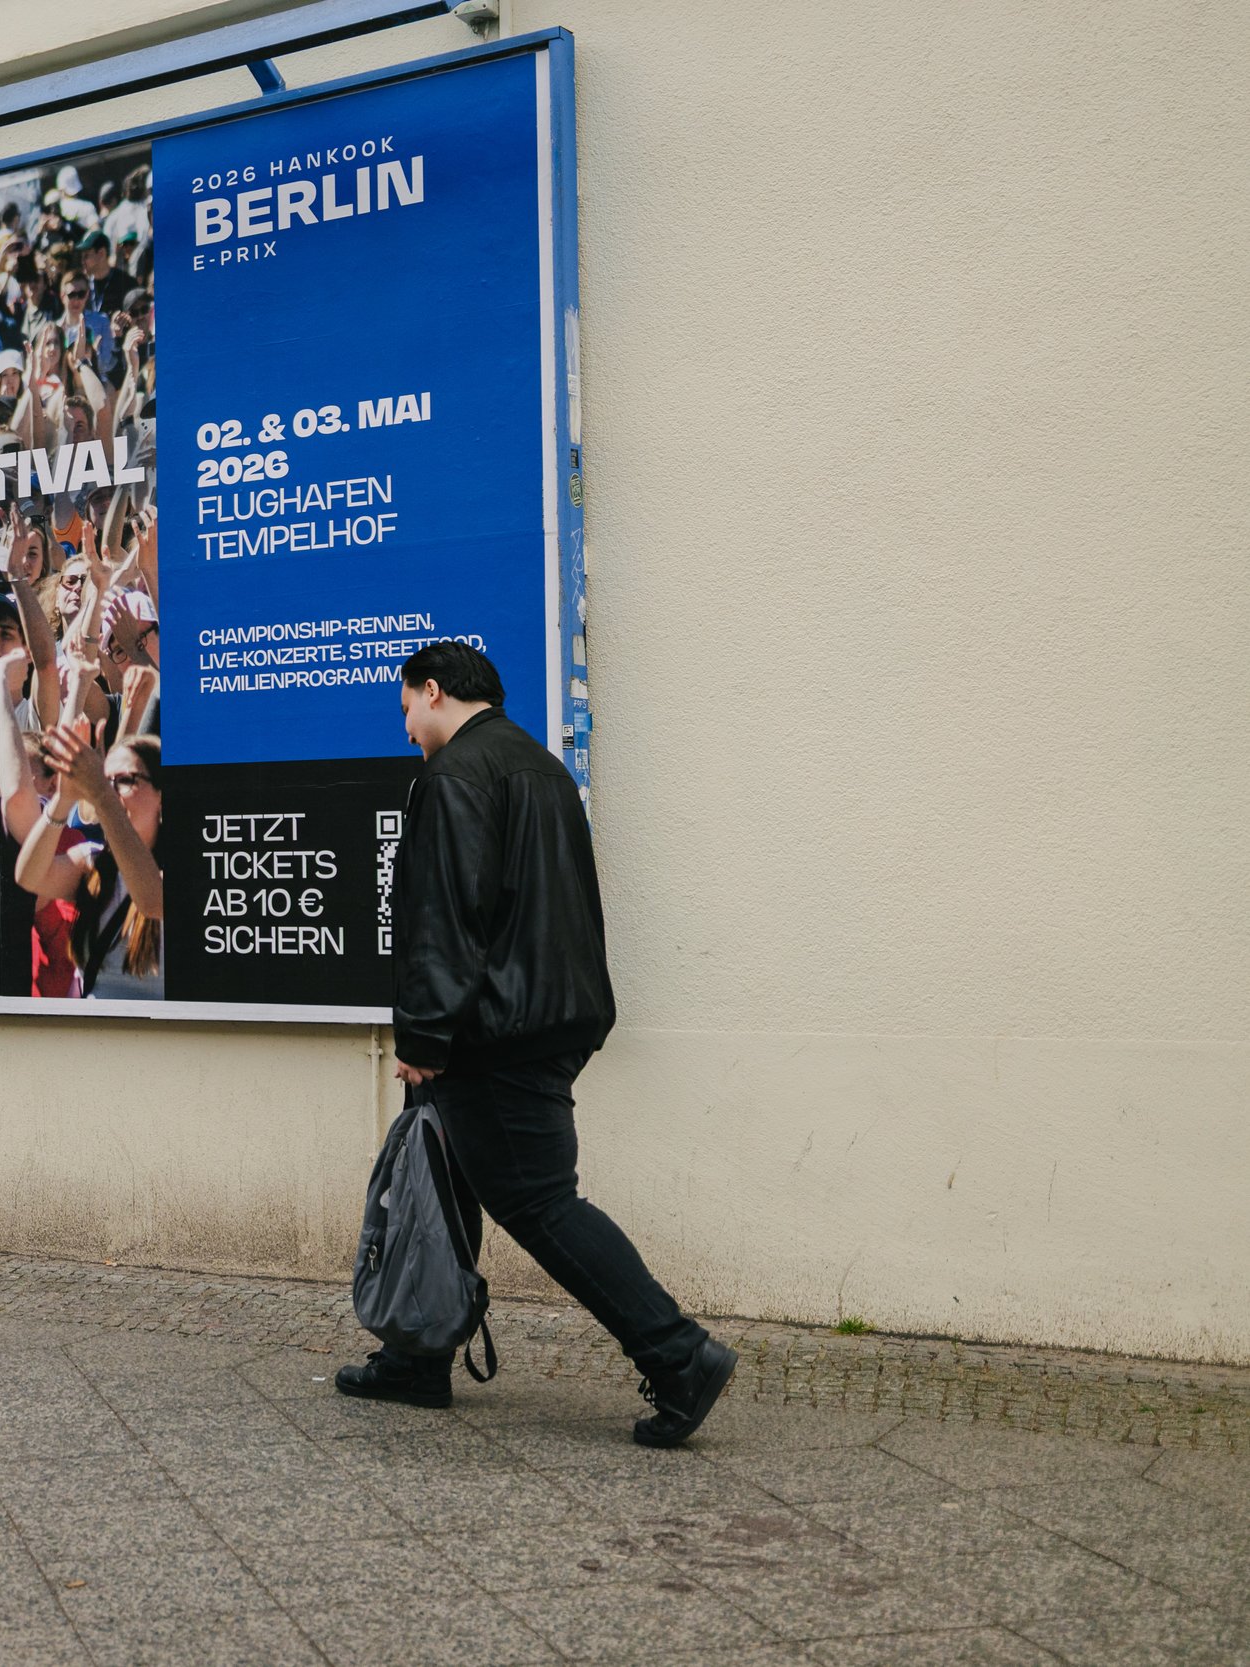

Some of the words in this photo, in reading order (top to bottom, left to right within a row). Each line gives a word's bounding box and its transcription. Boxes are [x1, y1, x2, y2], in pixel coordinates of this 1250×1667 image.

[191, 165, 257, 194] 2026
[269, 135, 395, 177] HANKOOK
[194, 154, 425, 247] BERLIN
[193, 240, 278, 271] E-PRIX
[196, 420, 251, 451] 02.
[257, 413, 286, 443] &
[292, 405, 350, 438] 03.
[358, 391, 432, 430] MAI
[196, 450, 290, 489] 2026
[198, 474, 393, 525] FLUGHAFEN
[197, 512, 398, 560] TEMPELHOF
[199, 613, 435, 647] CHAMPIONSHIP-RENNEN,
[200, 643, 347, 671] LIVE-KONZERTE,
[200, 664, 403, 694] FAMILIENPROGRAMM
[202, 813, 306, 843] JETZT
[202, 850, 338, 880] TICKETS
[203, 888, 248, 917] AB
[252, 888, 292, 917] 10
[297, 888, 324, 917] €
[204, 925, 344, 955] SICHERN
